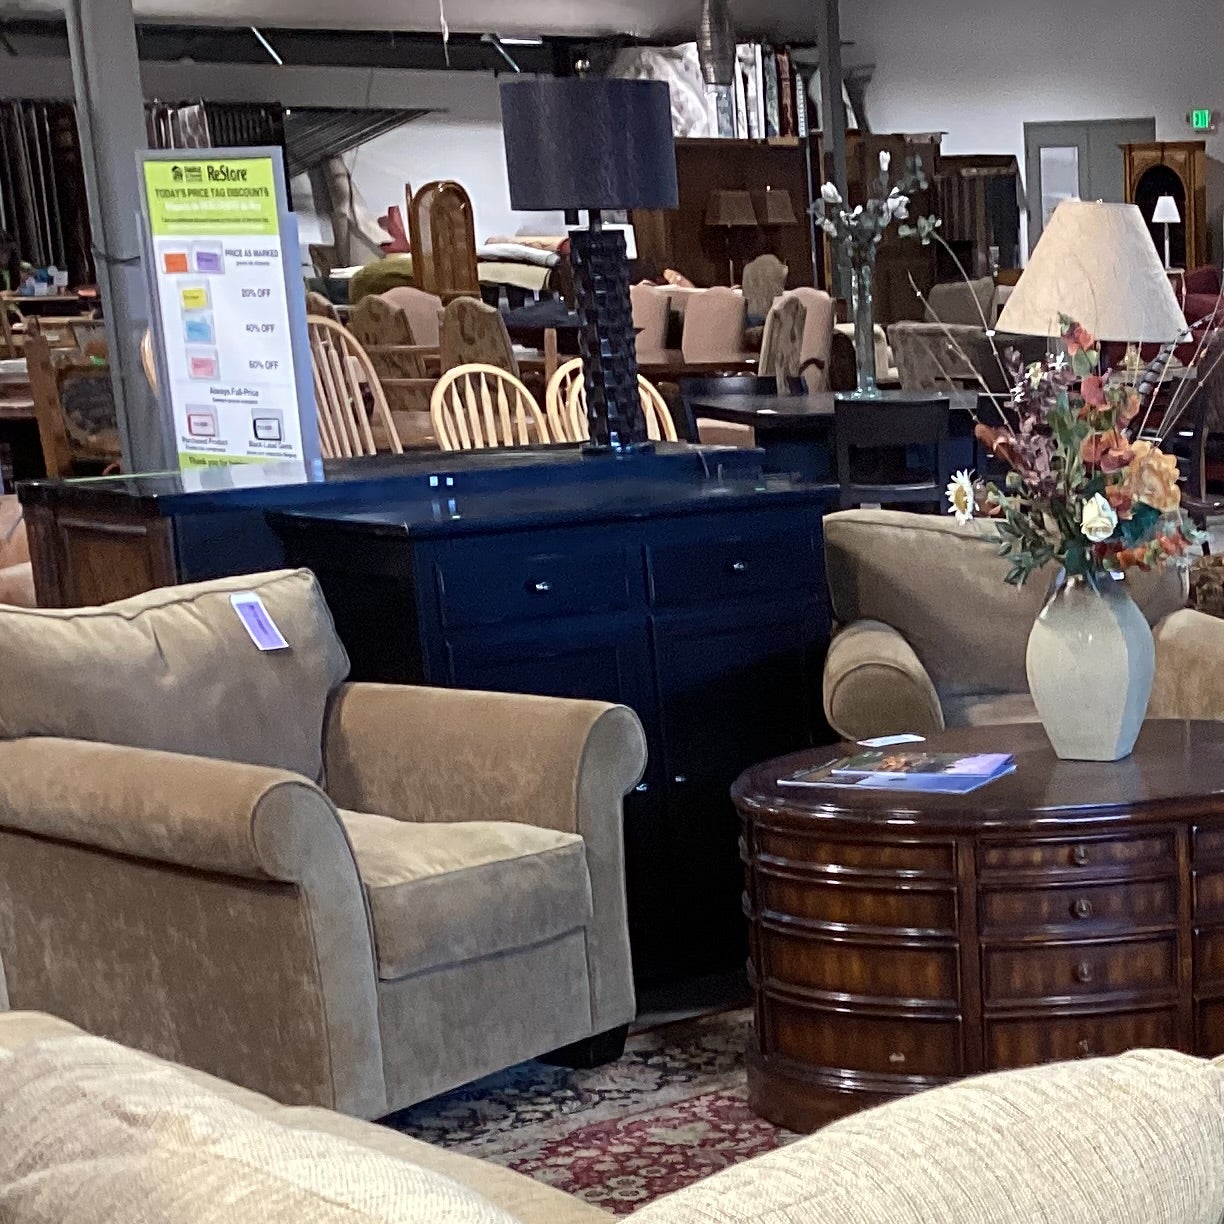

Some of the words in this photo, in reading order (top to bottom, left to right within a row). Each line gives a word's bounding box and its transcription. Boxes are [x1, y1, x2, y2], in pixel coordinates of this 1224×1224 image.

[207, 165, 247, 181] ReStore
[155, 188, 186, 198] TODAY'S
[188, 188, 208, 198] PRICE
[211, 188, 225, 197] TAG
[227, 187, 269, 197] DISCOUNTS
[225, 249, 242, 257] PRICE
[244, 249, 251, 257] AS
[253, 249, 278, 257] MARKED
[257, 289, 271, 297] OFF
[246, 324, 260, 332] 40%
[262, 324, 275, 333] OFF
[265, 361, 278, 370] OFF
